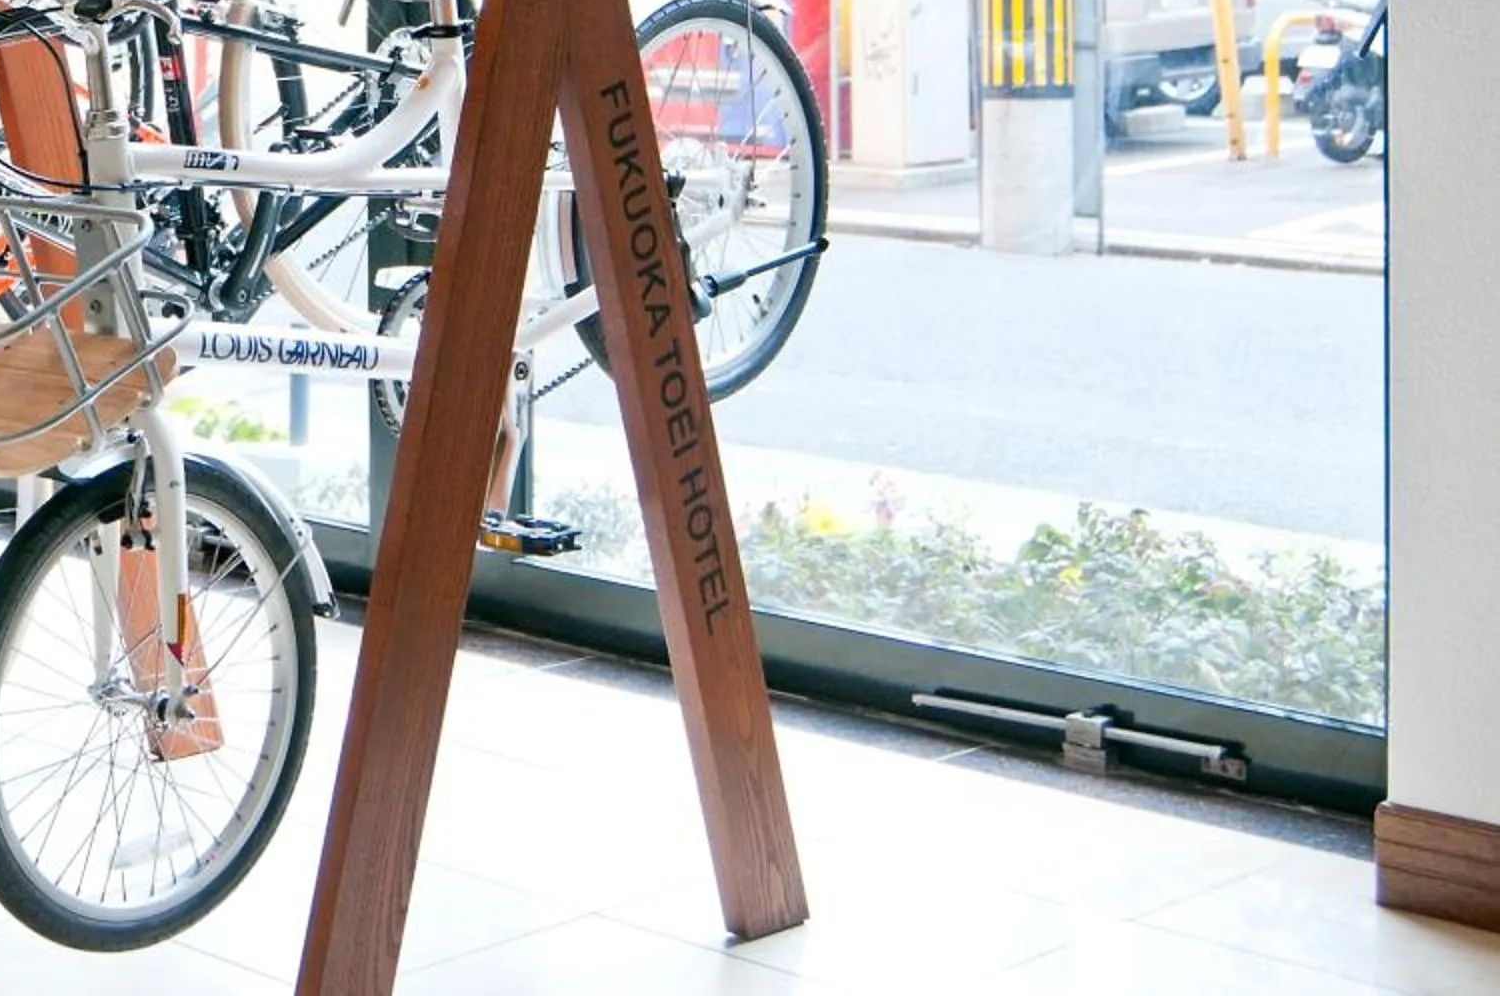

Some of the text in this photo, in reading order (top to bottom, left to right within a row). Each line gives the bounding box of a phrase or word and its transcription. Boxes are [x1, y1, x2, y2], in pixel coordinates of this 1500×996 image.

[199, 331, 273, 364] LOUIS
[600, 80, 731, 637] FUKUOKA TOEI HOTEL
